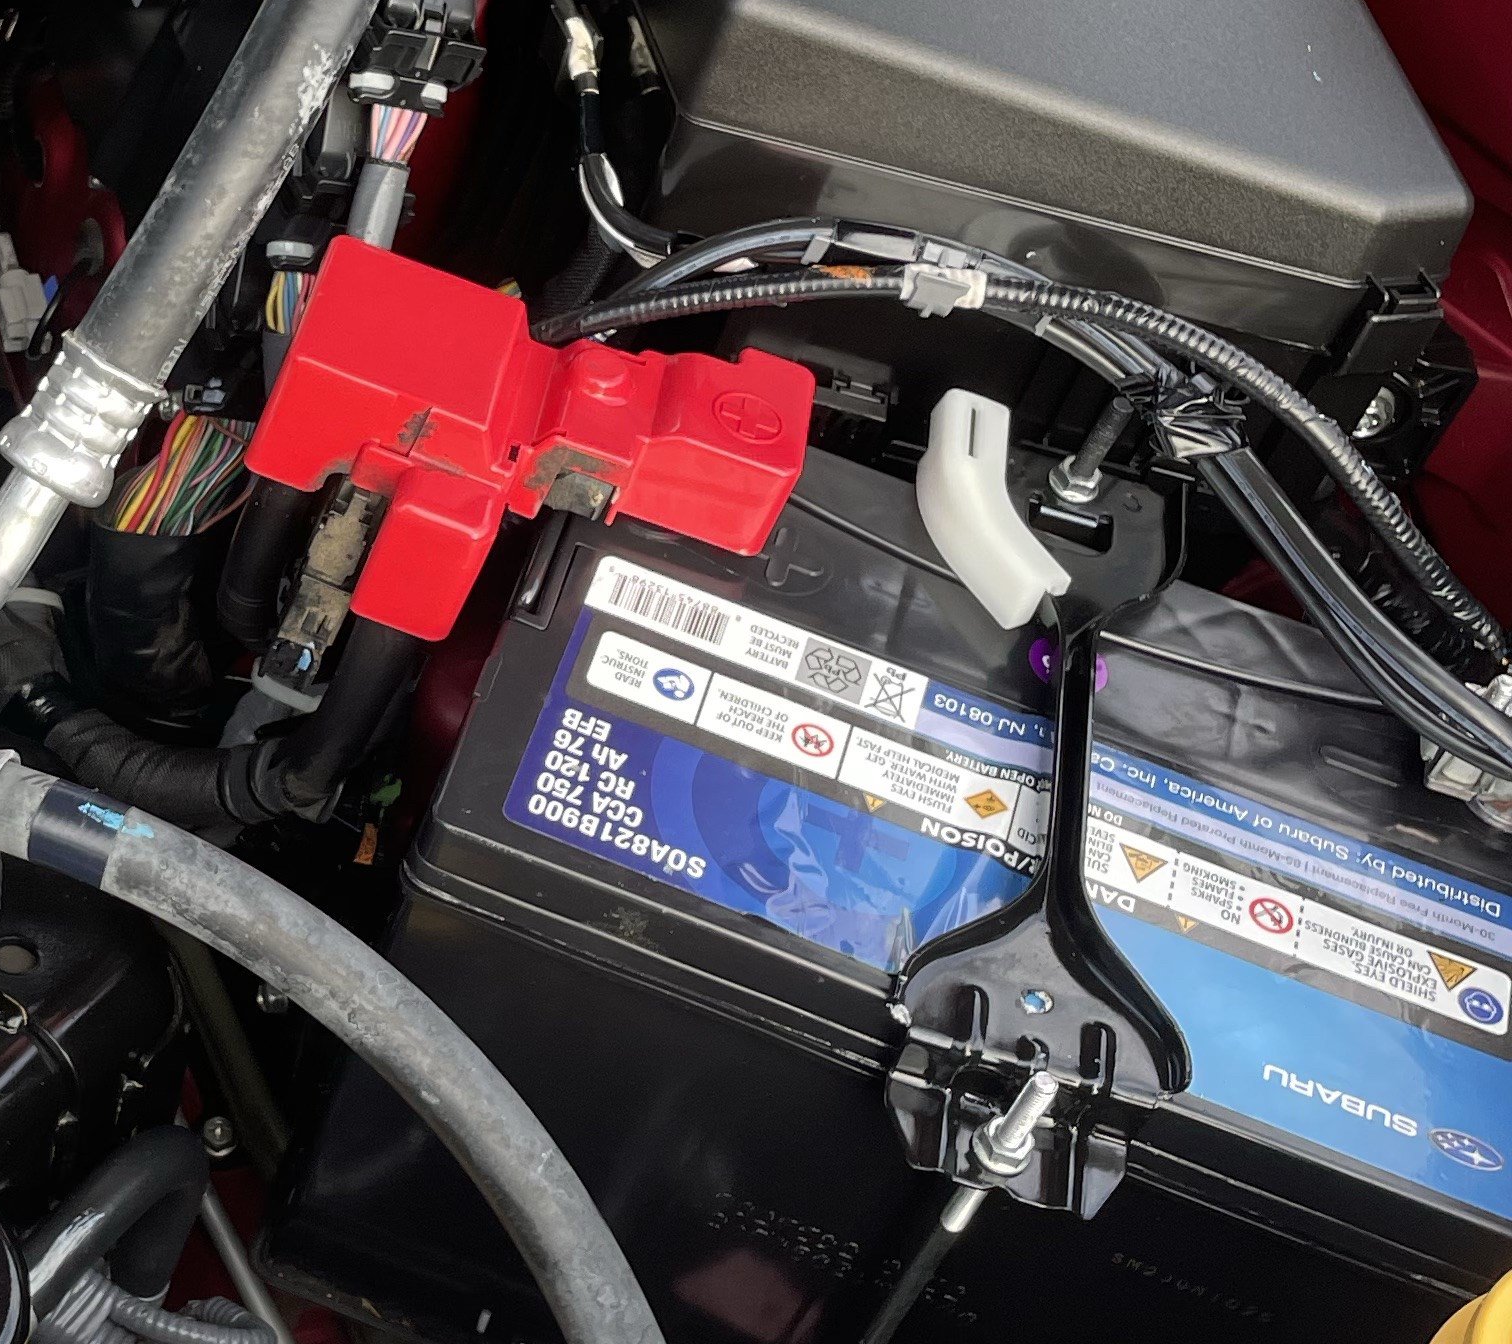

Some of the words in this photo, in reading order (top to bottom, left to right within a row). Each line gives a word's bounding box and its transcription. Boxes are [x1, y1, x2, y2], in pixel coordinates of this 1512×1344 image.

[748, 623, 800, 649] RECYCLED
[748, 635, 763, 647] BE
[743, 645, 789, 669] BATTERY
[762, 640, 793, 658] MUST
[613, 669, 643, 688] READ
[884, 665, 907, 681] Pb
[714, 709, 731, 723] OF
[727, 703, 767, 725] REACH
[773, 709, 789, 722] OF
[931, 692, 994, 726] 08103
[559, 706, 612, 742] EFB
[730, 715, 754, 732] OUT
[754, 724, 783, 742] KEEP
[766, 718, 786, 732] THE
[996, 715, 1026, 738] NJ
[550, 726, 588, 757] 76
[541, 747, 594, 784] 120
[588, 741, 628, 773] Ah
[864, 750, 886, 765] GET
[882, 746, 911, 763] HELP
[912, 758, 960, 782] MEDICAL
[998, 767, 1036, 787] OPEN
[1118, 762, 1157, 788] Inc.
[533, 769, 587, 805] 750
[594, 769, 636, 801] RC
[880, 768, 955, 802] IMMEDIATELY
[889, 782, 916, 799] EYES
[927, 775, 958, 793] WITH
[585, 790, 645, 829] CCA
[917, 793, 953, 814] FLUSH
[1093, 780, 1179, 822] Replacement
[1159, 777, 1250, 822] America,
[1251, 813, 1273, 831] of
[1275, 821, 1351, 861] Subaru
[1352, 848, 1388, 874] by:
[1180, 861, 1237, 889] SMOKING
[1190, 875, 1235, 899] FLAMES
[1310, 864, 1398, 904] Replacement
[1189, 885, 1234, 909] SPARKS
[1388, 864, 1503, 918] Distributed
[1218, 907, 1242, 924] NO
[1397, 897, 1429, 916] Free
[1302, 919, 1368, 951] BLINDNESS
[1320, 937, 1366, 962] GASES
[1367, 944, 1406, 966] CAUSE
[1393, 943, 1414, 958] OR
[1365, 955, 1438, 990] EXPLOSIVE
[1405, 959, 1432, 976] CAN
[1386, 975, 1438, 1002] SHIELD
[1259, 1062, 1421, 1138] SUBARU
